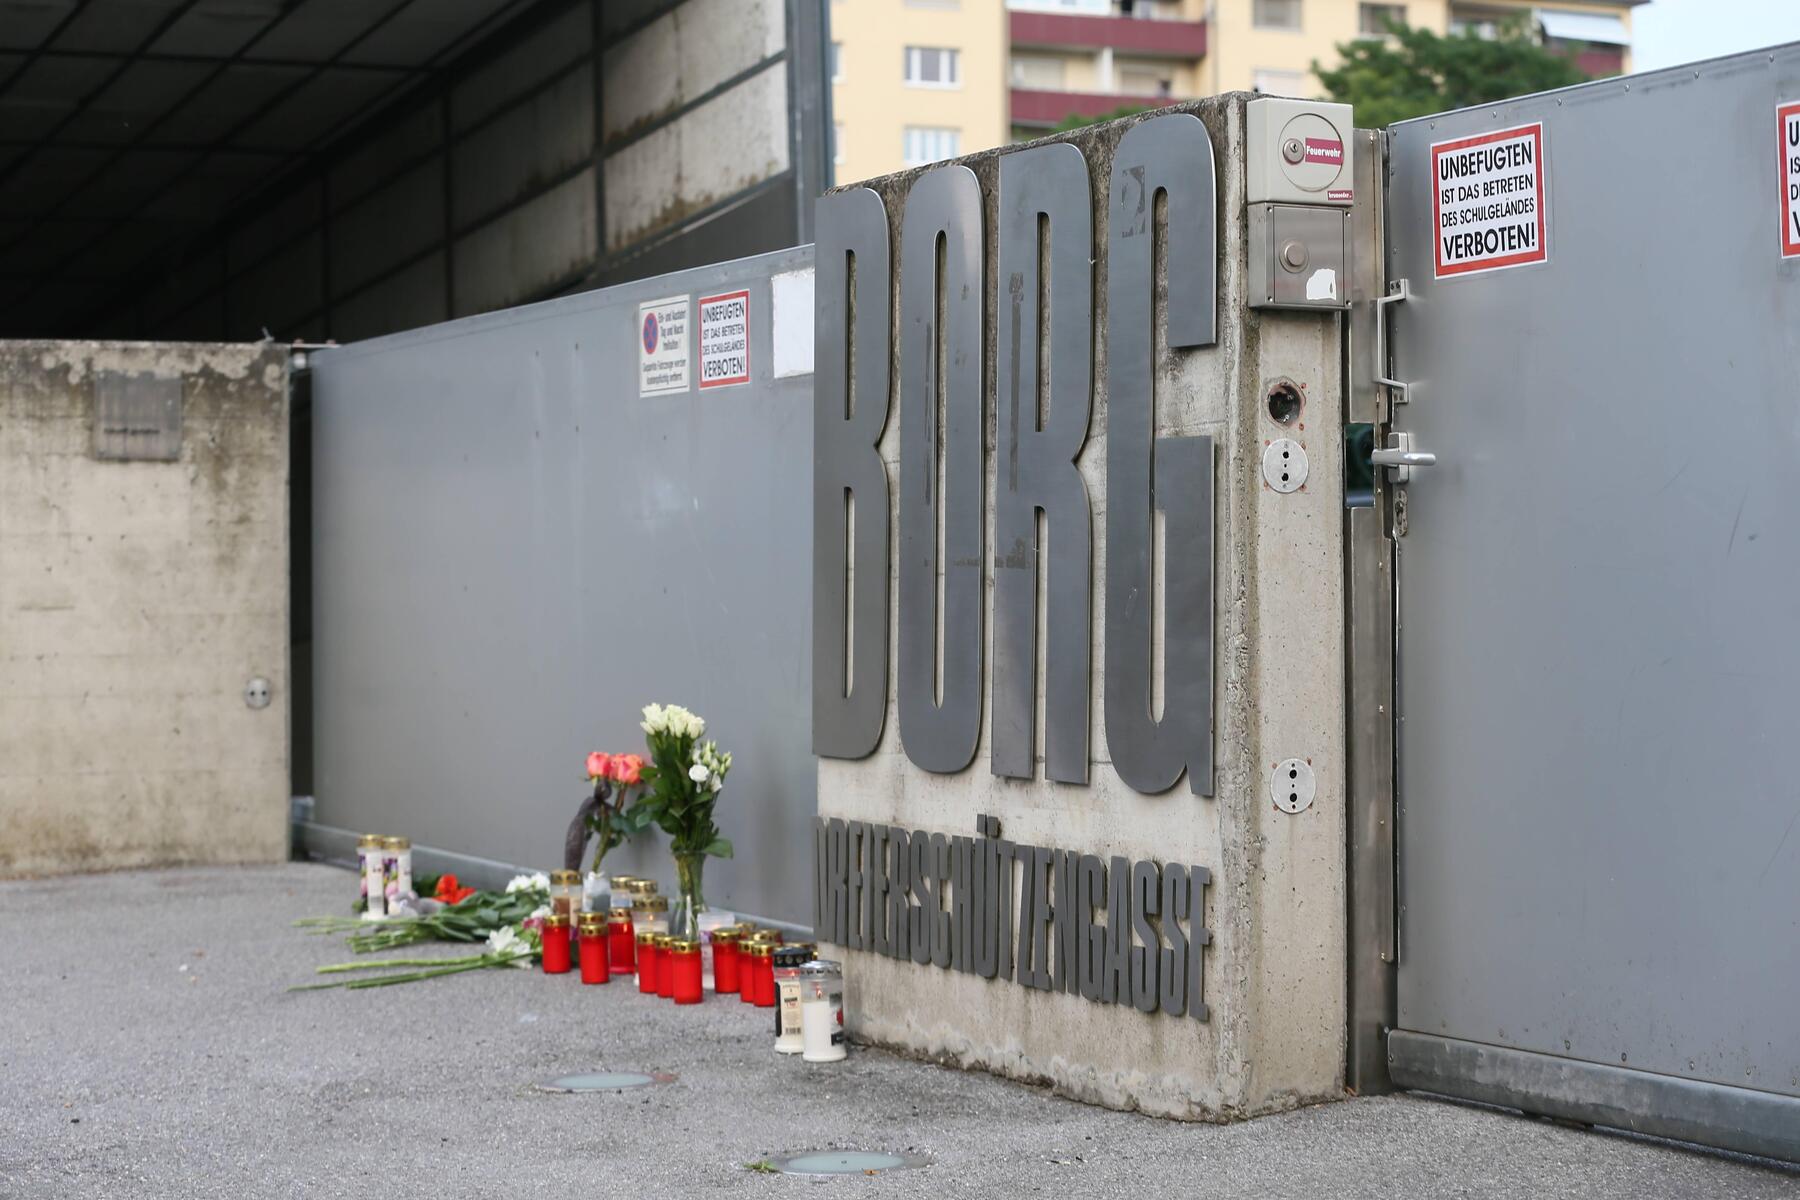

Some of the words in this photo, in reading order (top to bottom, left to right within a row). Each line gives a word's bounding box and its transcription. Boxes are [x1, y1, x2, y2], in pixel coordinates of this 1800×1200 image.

[1306, 145, 1341, 158] Feuerwehr
[1440, 141, 1532, 181] UNBEFUGTEN
[1790, 156, 1800, 175] IS
[1441, 187, 1455, 205] IST
[1458, 183, 1480, 202] DAS
[1483, 173, 1533, 197] BETRETEN
[1441, 212, 1458, 228] DES
[1460, 197, 1535, 224] SCHULGELÄNDES
[1443, 221, 1536, 260] VERBOTEN!
[703, 301, 745, 323] UNBEFUGTEN
[711, 327, 720, 339] DAS
[721, 323, 745, 337] BETRETEN
[703, 356, 745, 377] VERBOTEN!
[812, 113, 1217, 798] BORG
[813, 813, 1212, 1023] DREIERSCHÜTZENGASSE
